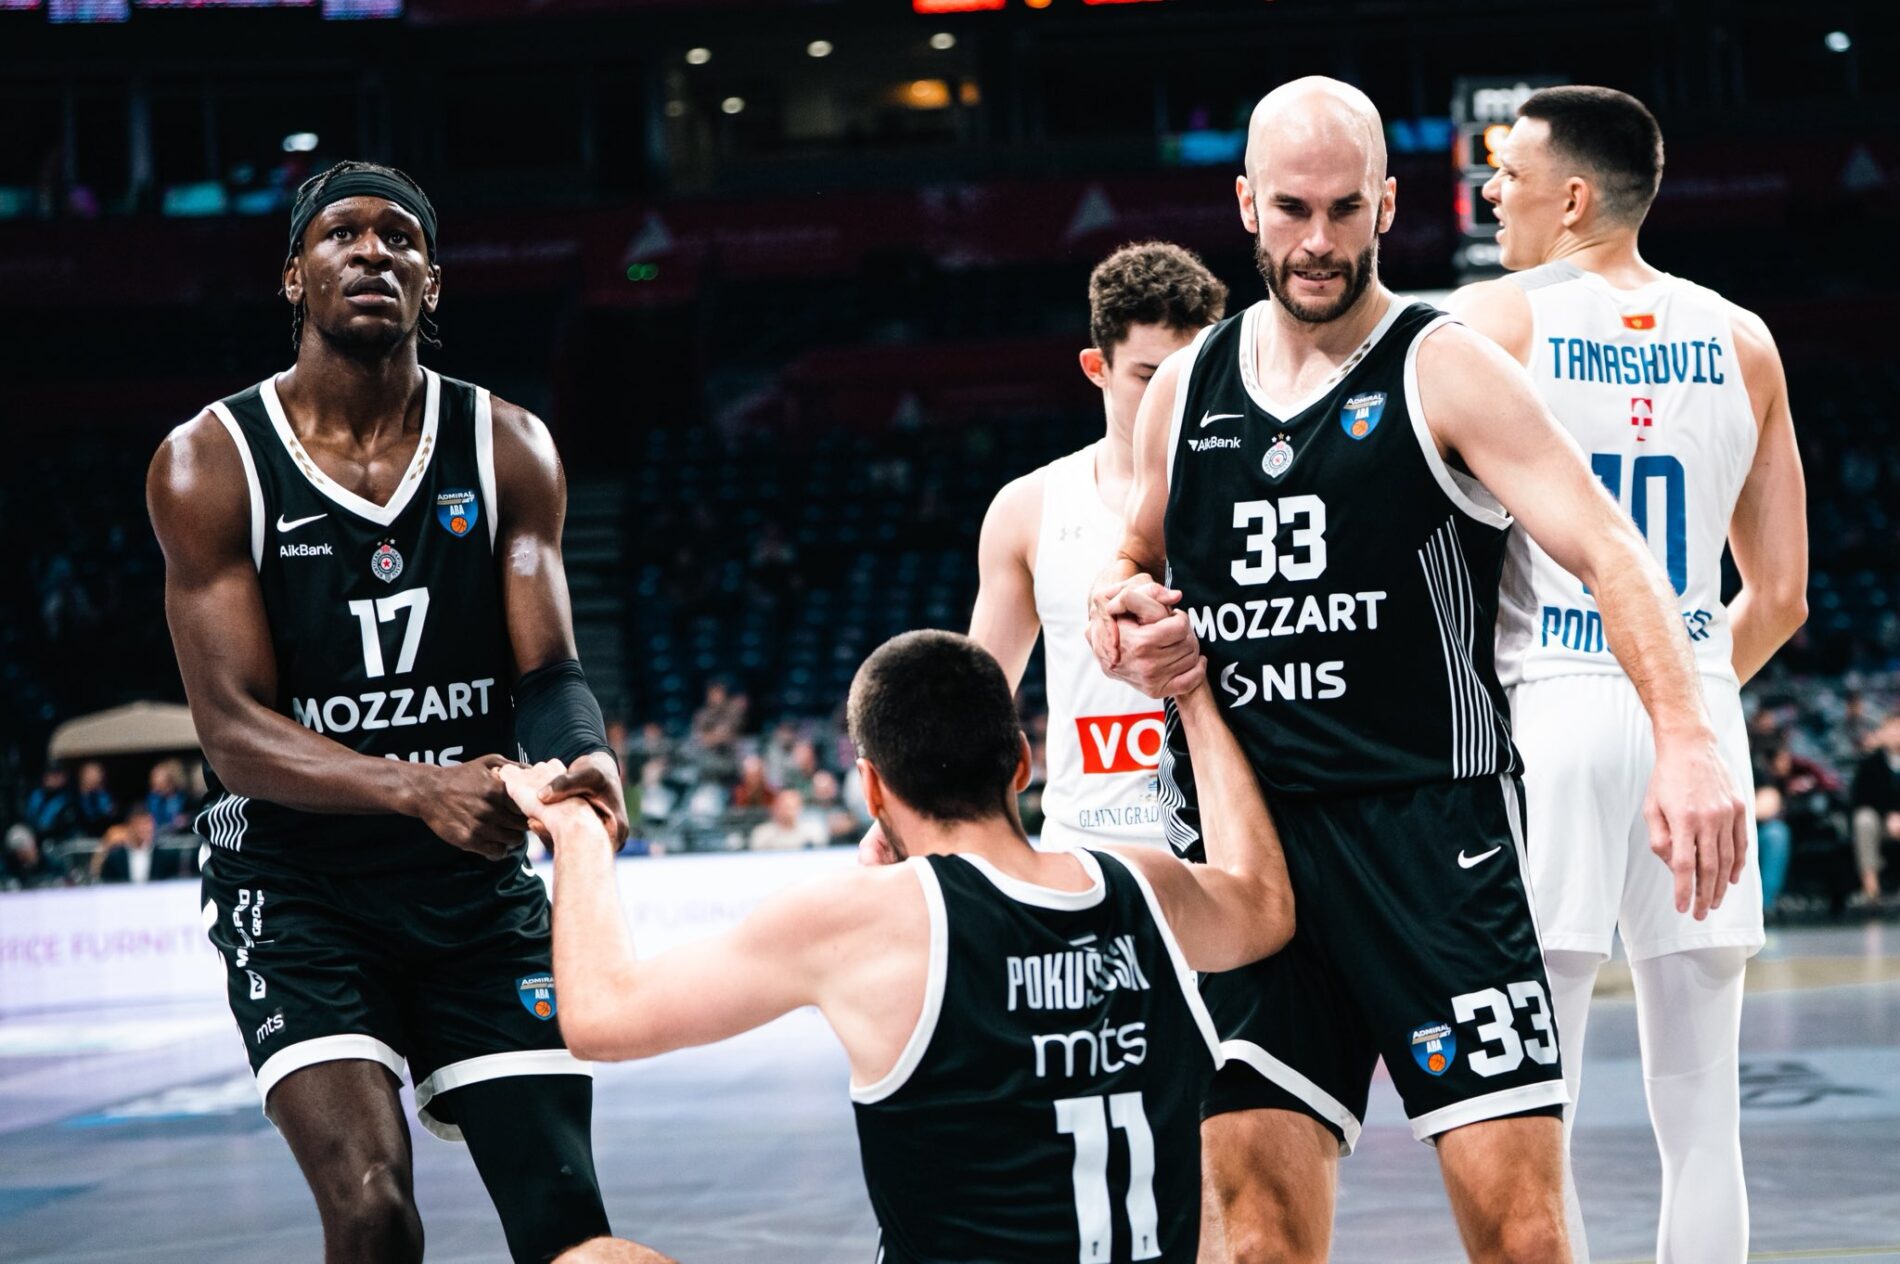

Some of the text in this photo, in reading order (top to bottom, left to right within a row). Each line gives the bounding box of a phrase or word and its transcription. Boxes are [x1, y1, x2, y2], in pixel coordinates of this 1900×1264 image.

[450, 504, 465, 516] ABA
[280, 543, 333, 558] AikBank
[1231, 494, 1327, 586] 33
[348, 587, 430, 678] 17
[1188, 591, 1387, 642] MOZZART
[1262, 660, 1347, 702] NIS
[292, 677, 495, 734] MOZZART
[1079, 805, 1159, 828] GLAVNI GRAD
[534, 988, 550, 999] ABA
[256, 1013, 285, 1044] mts
[1031, 1018, 1148, 1078] mts
[1412, 1023, 1449, 1039] ADMIRAL
[1426, 1039, 1443, 1054] ABA
[1451, 980, 1559, 1078] 33
[1053, 1091, 1163, 1264] 11
